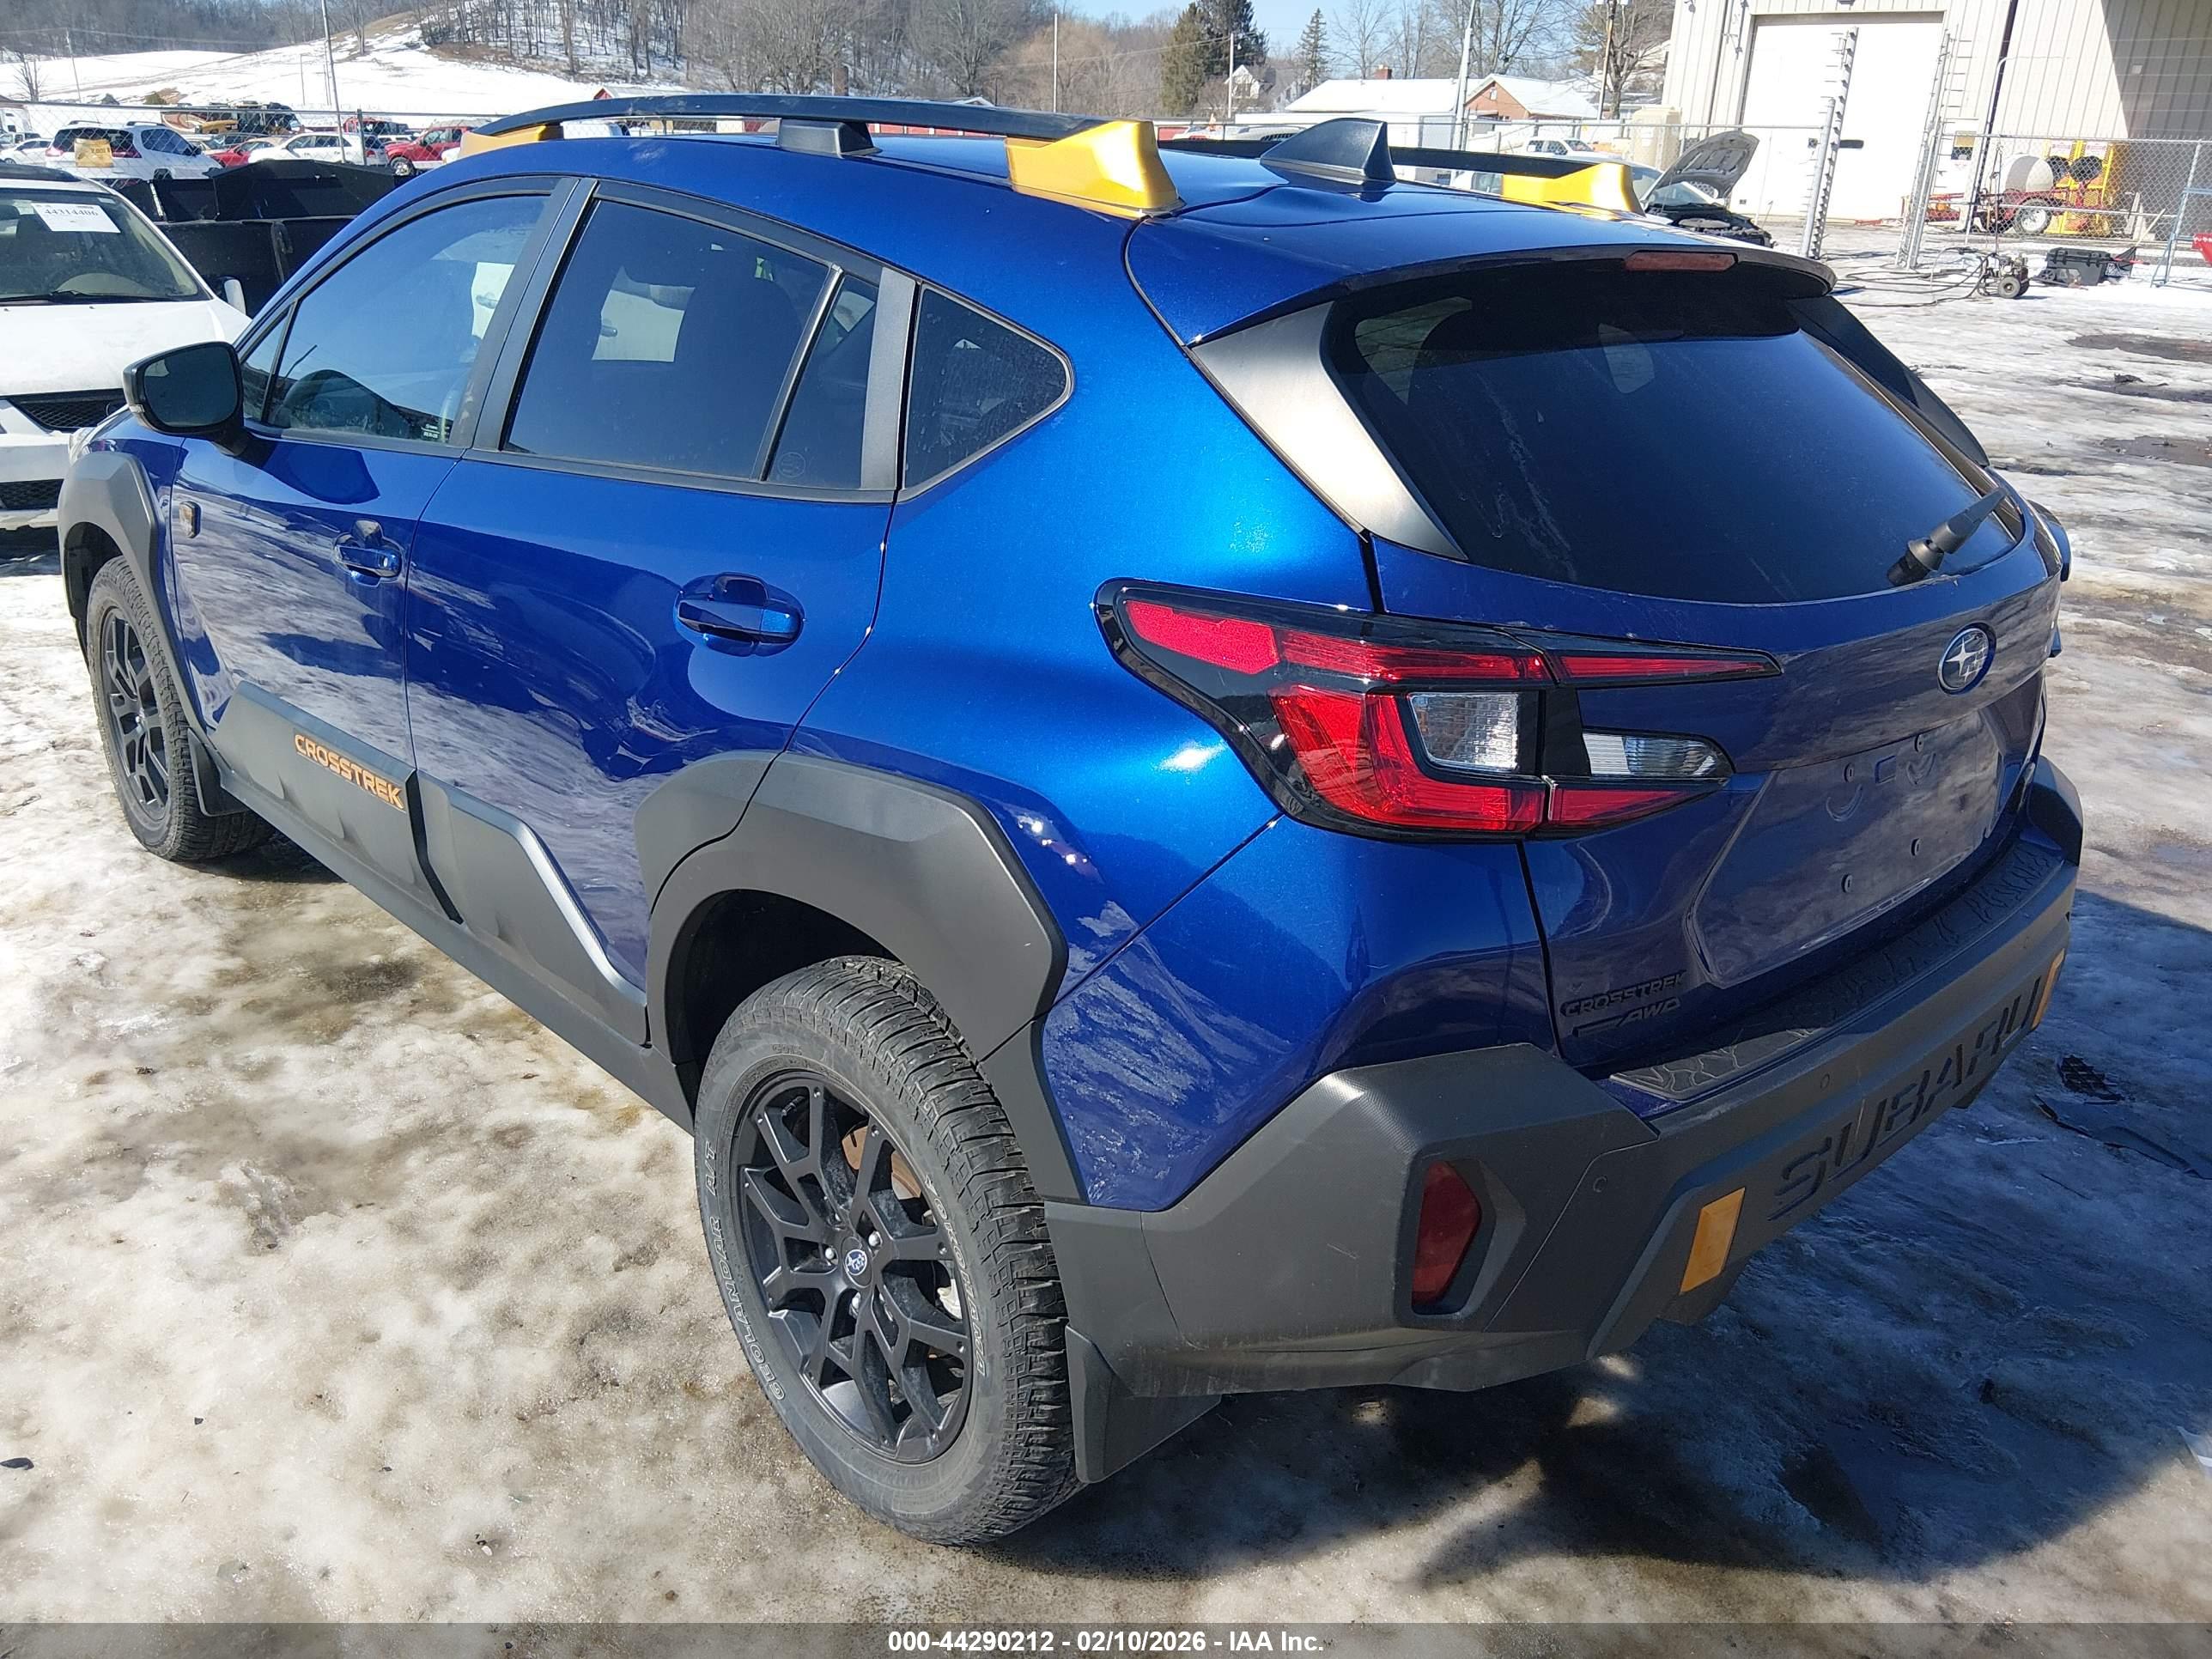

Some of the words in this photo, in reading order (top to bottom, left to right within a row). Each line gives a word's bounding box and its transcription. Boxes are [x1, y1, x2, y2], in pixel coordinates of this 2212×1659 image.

[295, 734, 404, 809] CROSSTREK
[1560, 969, 1686, 1017] CROSSTREK
[1618, 996, 1681, 1027] AWD
[1767, 975, 2042, 1221] SUBARU
[704, 1140, 717, 1197] A/T
[709, 1216, 785, 1401] GEOLANDAR
[926, 1174, 987, 1376] YOKOHAMA
